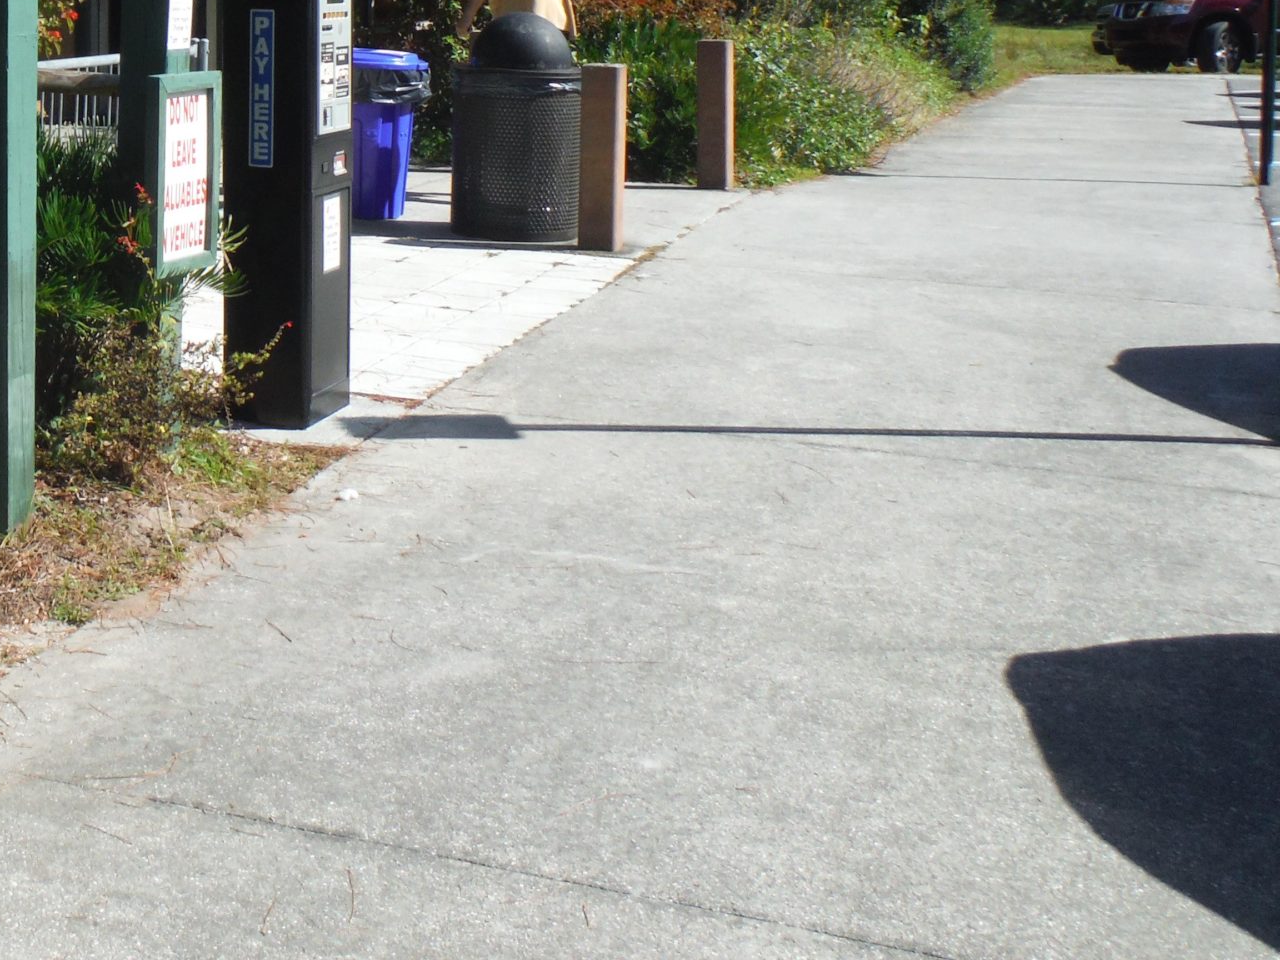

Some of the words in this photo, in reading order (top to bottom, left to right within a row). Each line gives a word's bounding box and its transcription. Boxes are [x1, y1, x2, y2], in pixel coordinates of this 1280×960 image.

[254, 16, 270, 75] PAY
[169, 97, 181, 126] DO
[183, 95, 199, 124] NOT
[253, 83, 269, 161] HERE
[172, 137, 197, 168] LEAVE
[164, 178, 208, 212] ALUABLES
